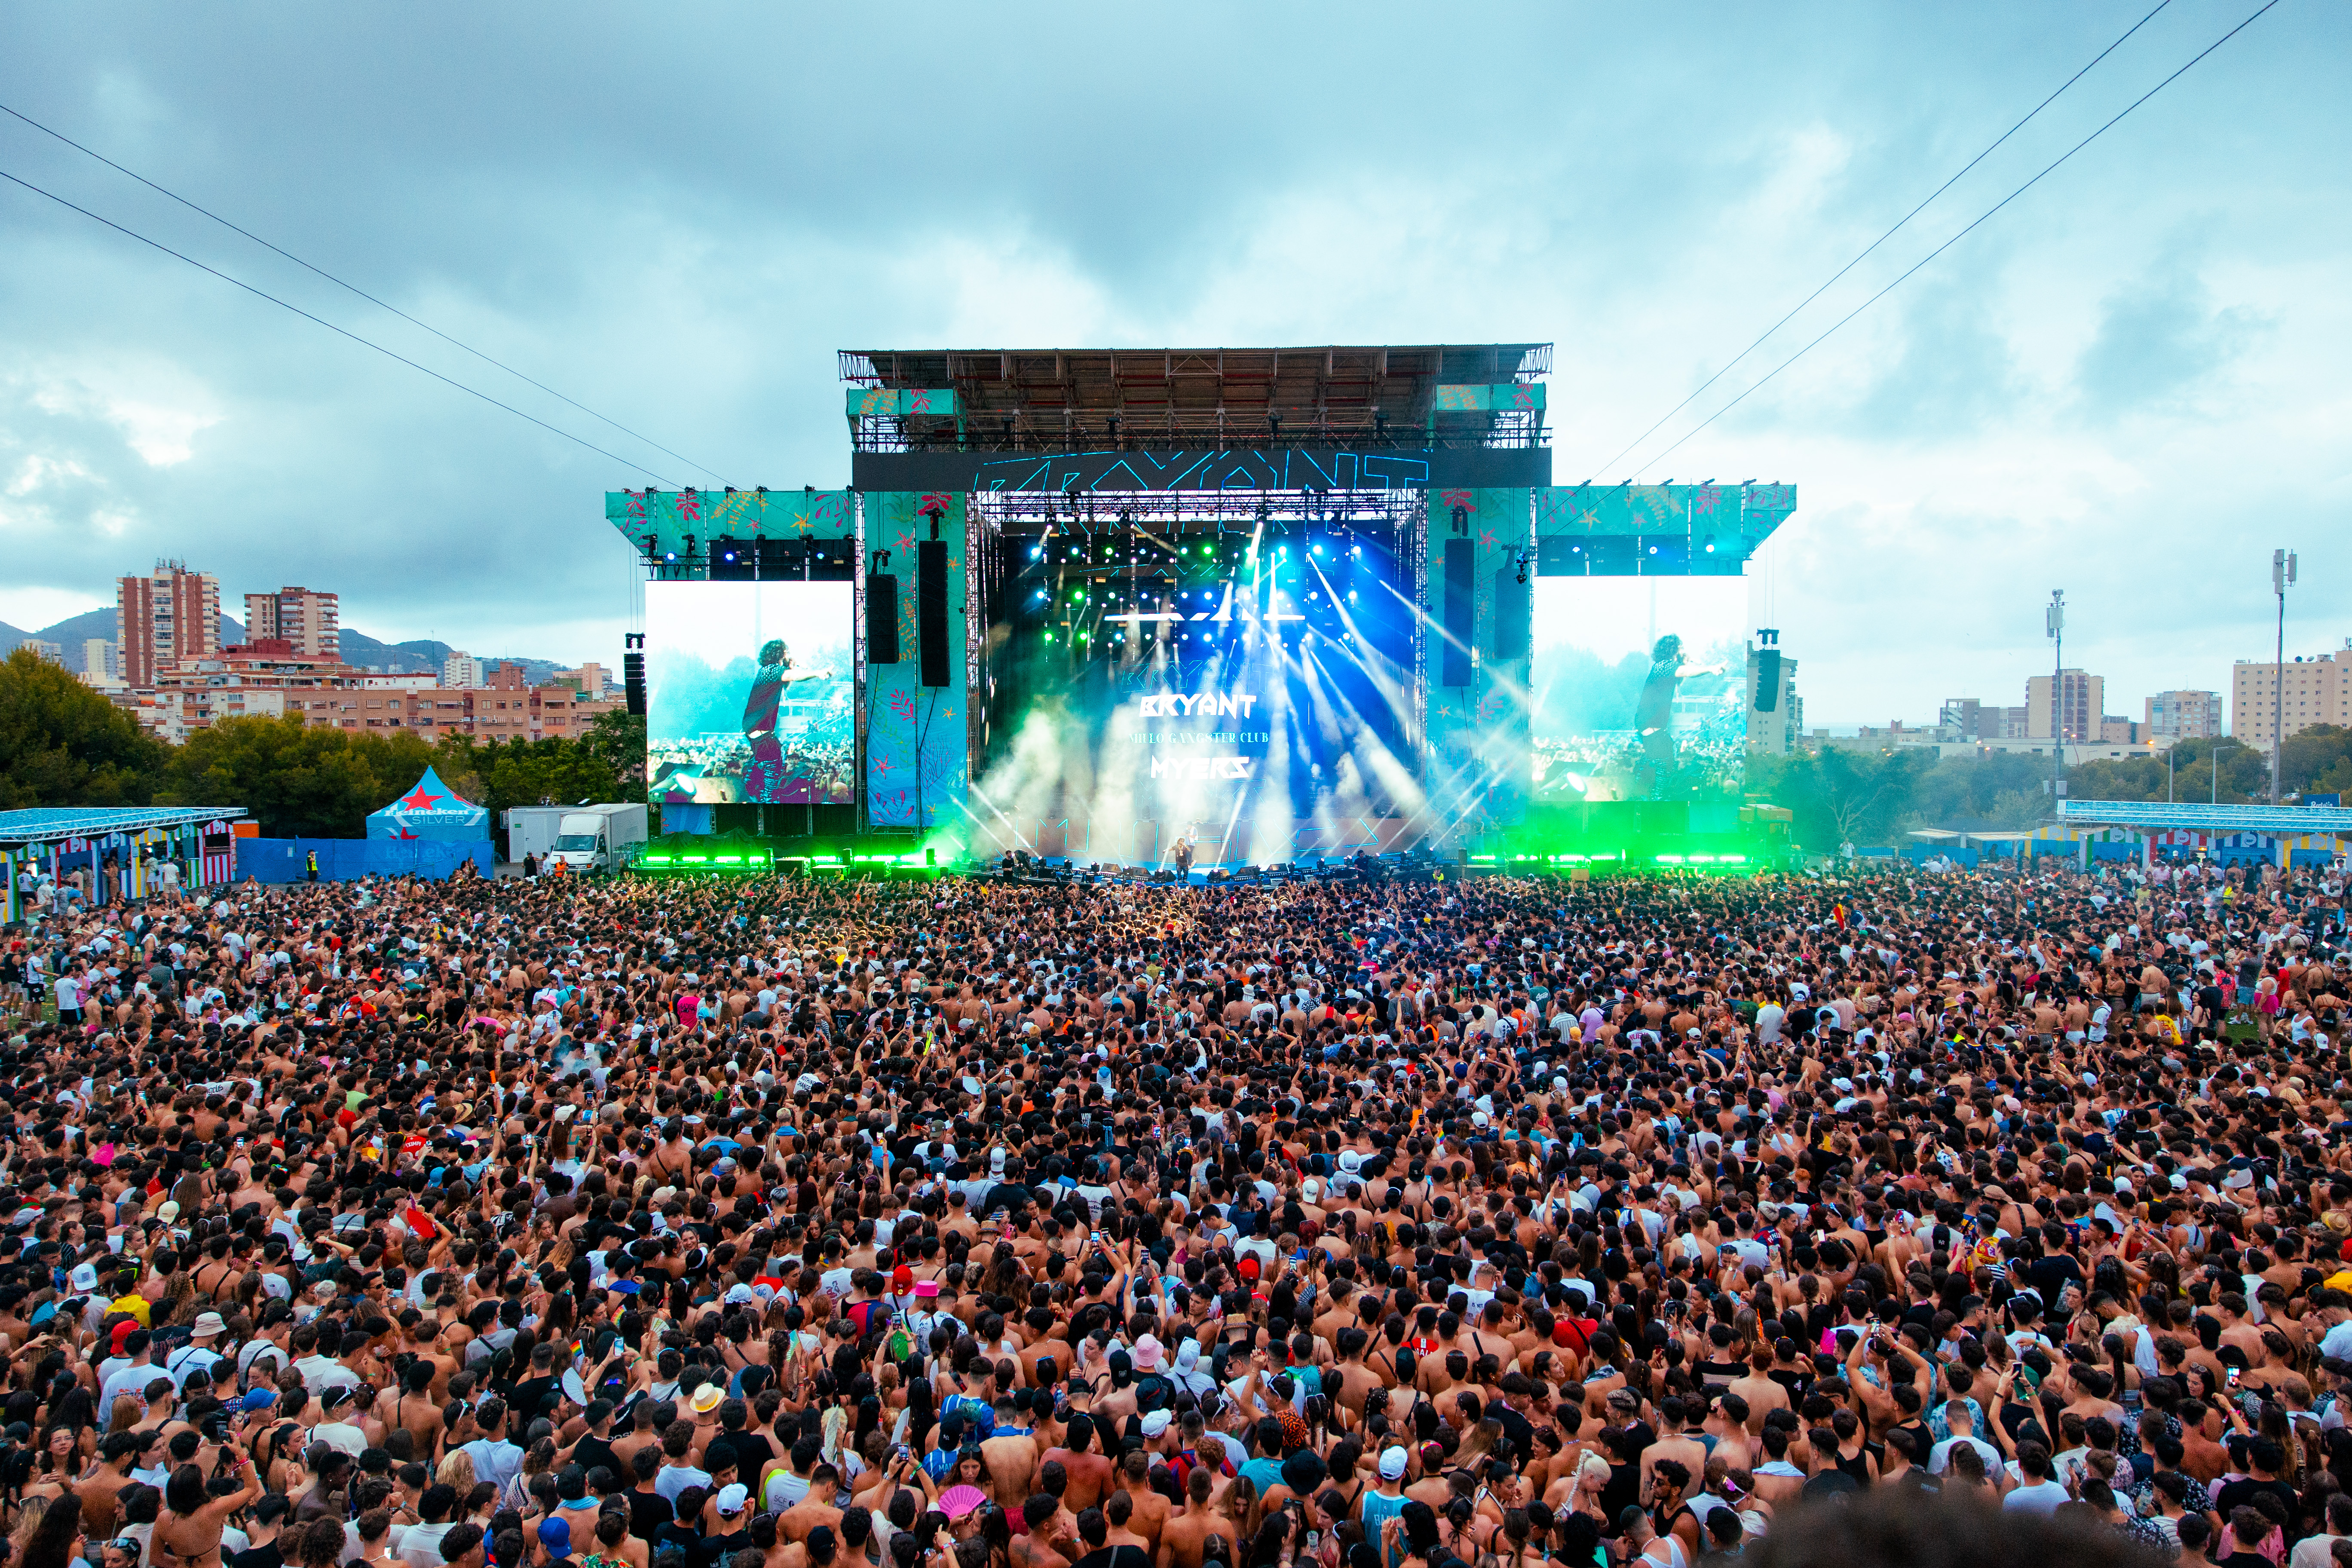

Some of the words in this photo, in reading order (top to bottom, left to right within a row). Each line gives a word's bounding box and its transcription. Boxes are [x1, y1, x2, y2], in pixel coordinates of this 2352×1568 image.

[1139, 690, 1256, 720] BRYANT
[1169, 732, 1236, 744] GANGSTER
[1240, 732, 1269, 743] CLUB
[1150, 755, 1250, 779] MYERS
[384, 808, 469, 816] Heineken
[412, 816, 465, 824] SILVER
